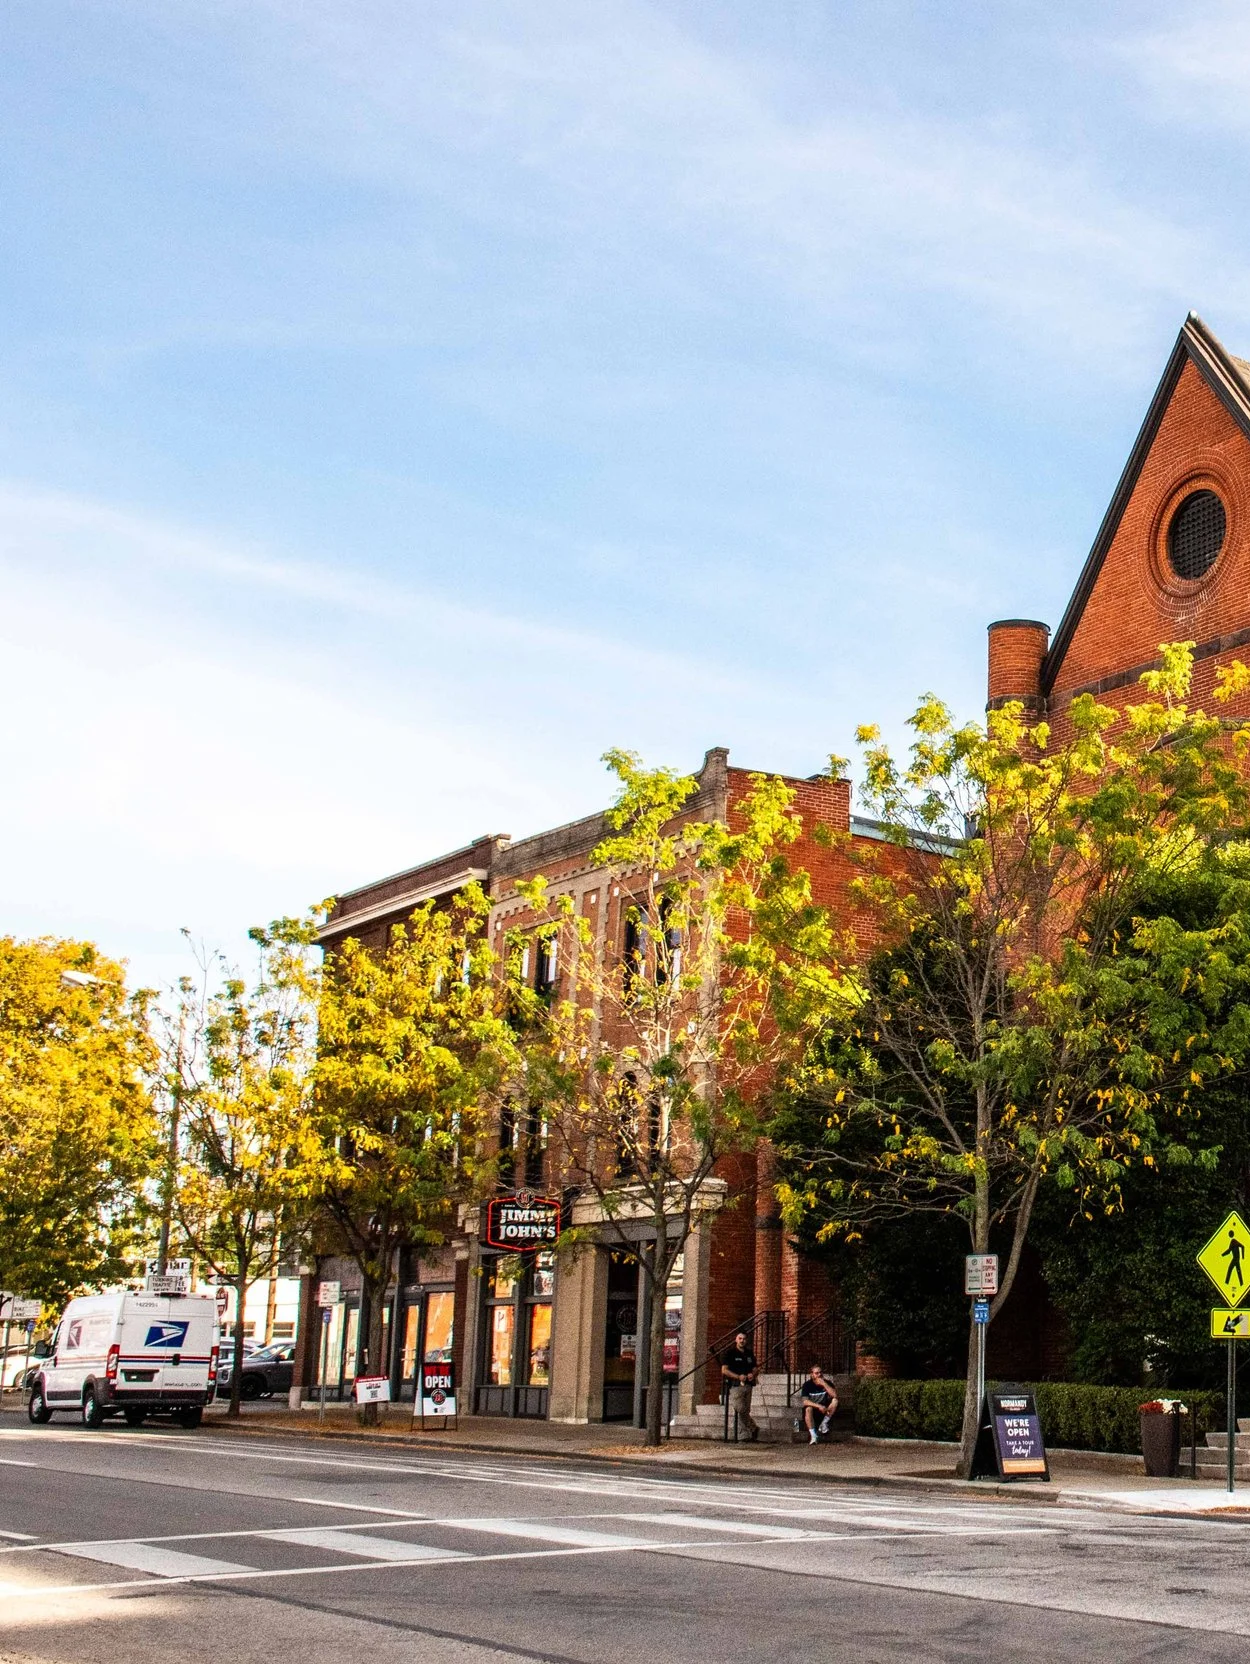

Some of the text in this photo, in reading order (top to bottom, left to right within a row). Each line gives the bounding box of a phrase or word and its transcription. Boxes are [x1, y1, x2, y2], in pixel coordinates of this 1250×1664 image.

[499, 1225, 556, 1240] JOHN'S
[425, 1375, 452, 1388] OPEN
[1004, 1419, 1030, 1427] WE'RE
[1007, 1428, 1030, 1437] OPEN
[1012, 1446, 1031, 1458] today!
